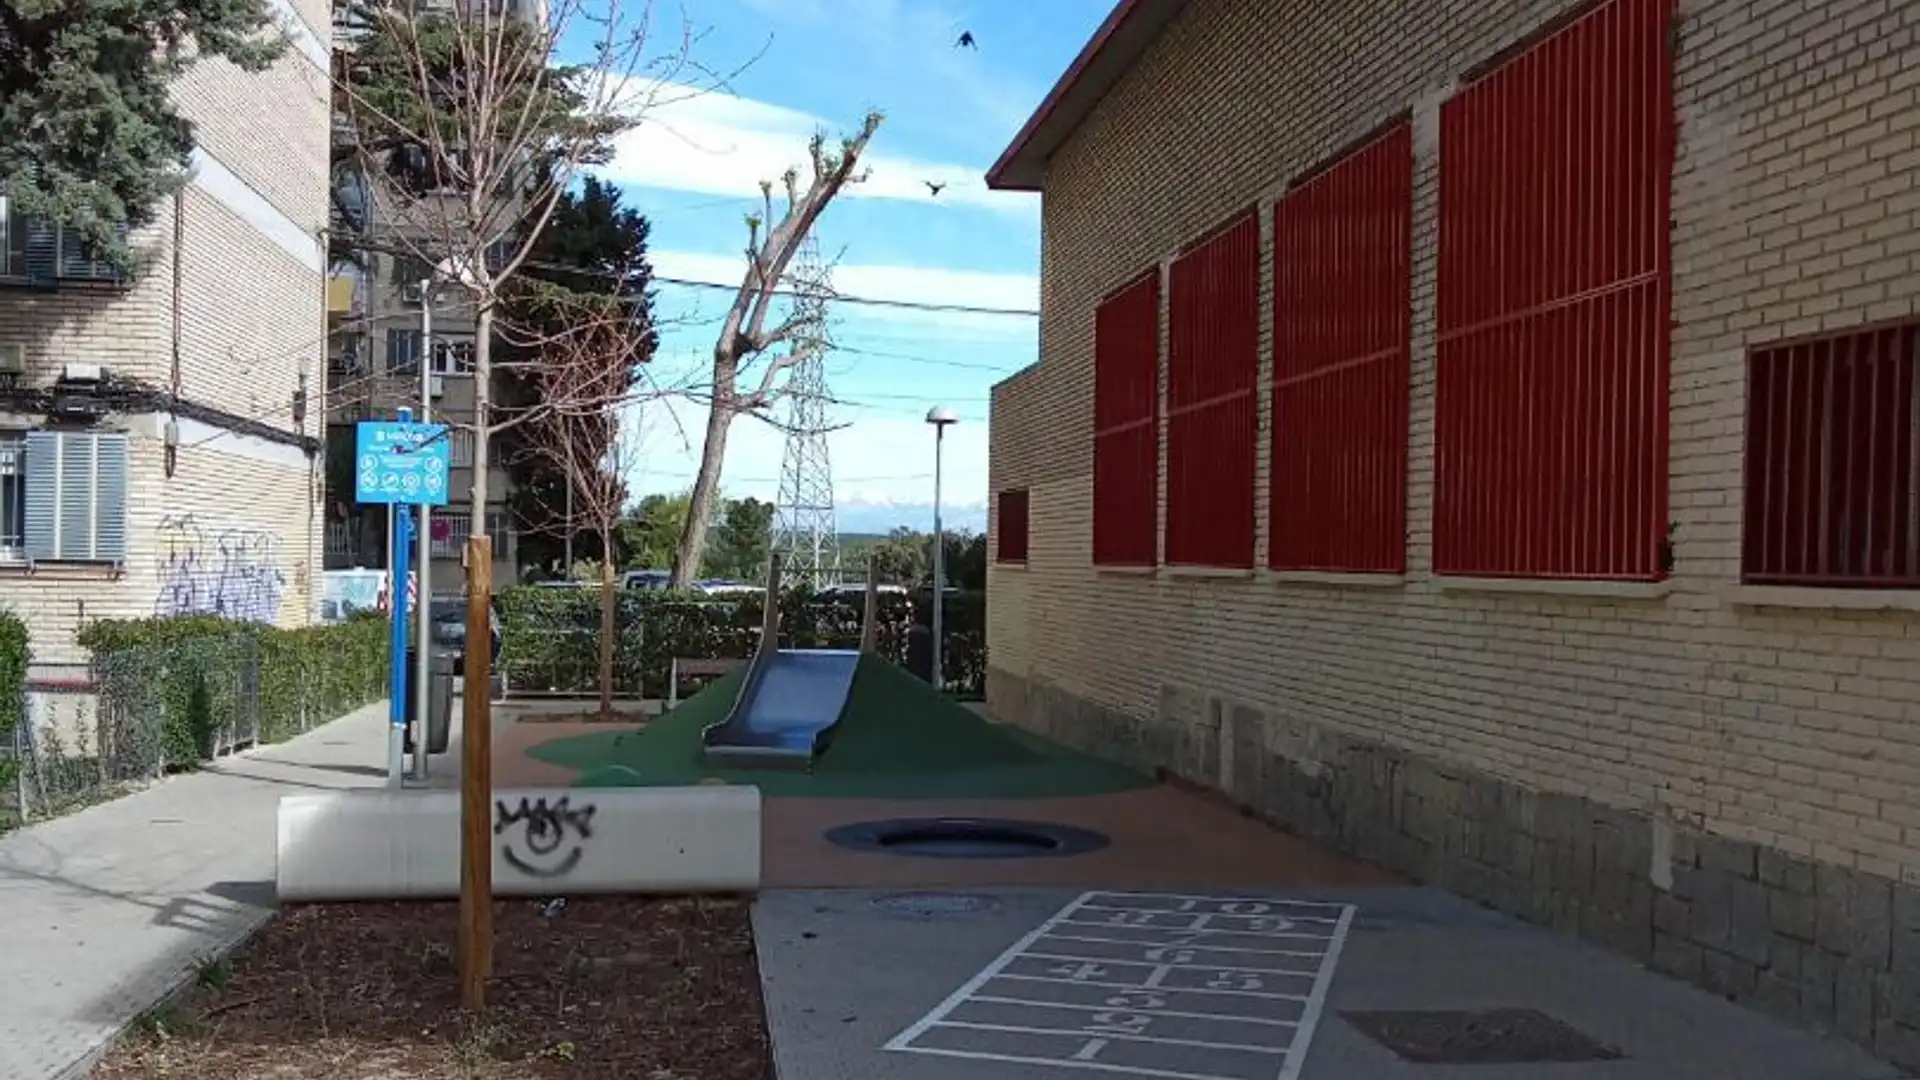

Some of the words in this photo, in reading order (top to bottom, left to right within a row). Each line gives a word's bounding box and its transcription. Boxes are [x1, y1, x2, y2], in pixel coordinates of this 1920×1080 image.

[1047, 962, 1107, 981] 4
[1206, 968, 1263, 990] 5
[1082, 1011, 1151, 1034] 2
